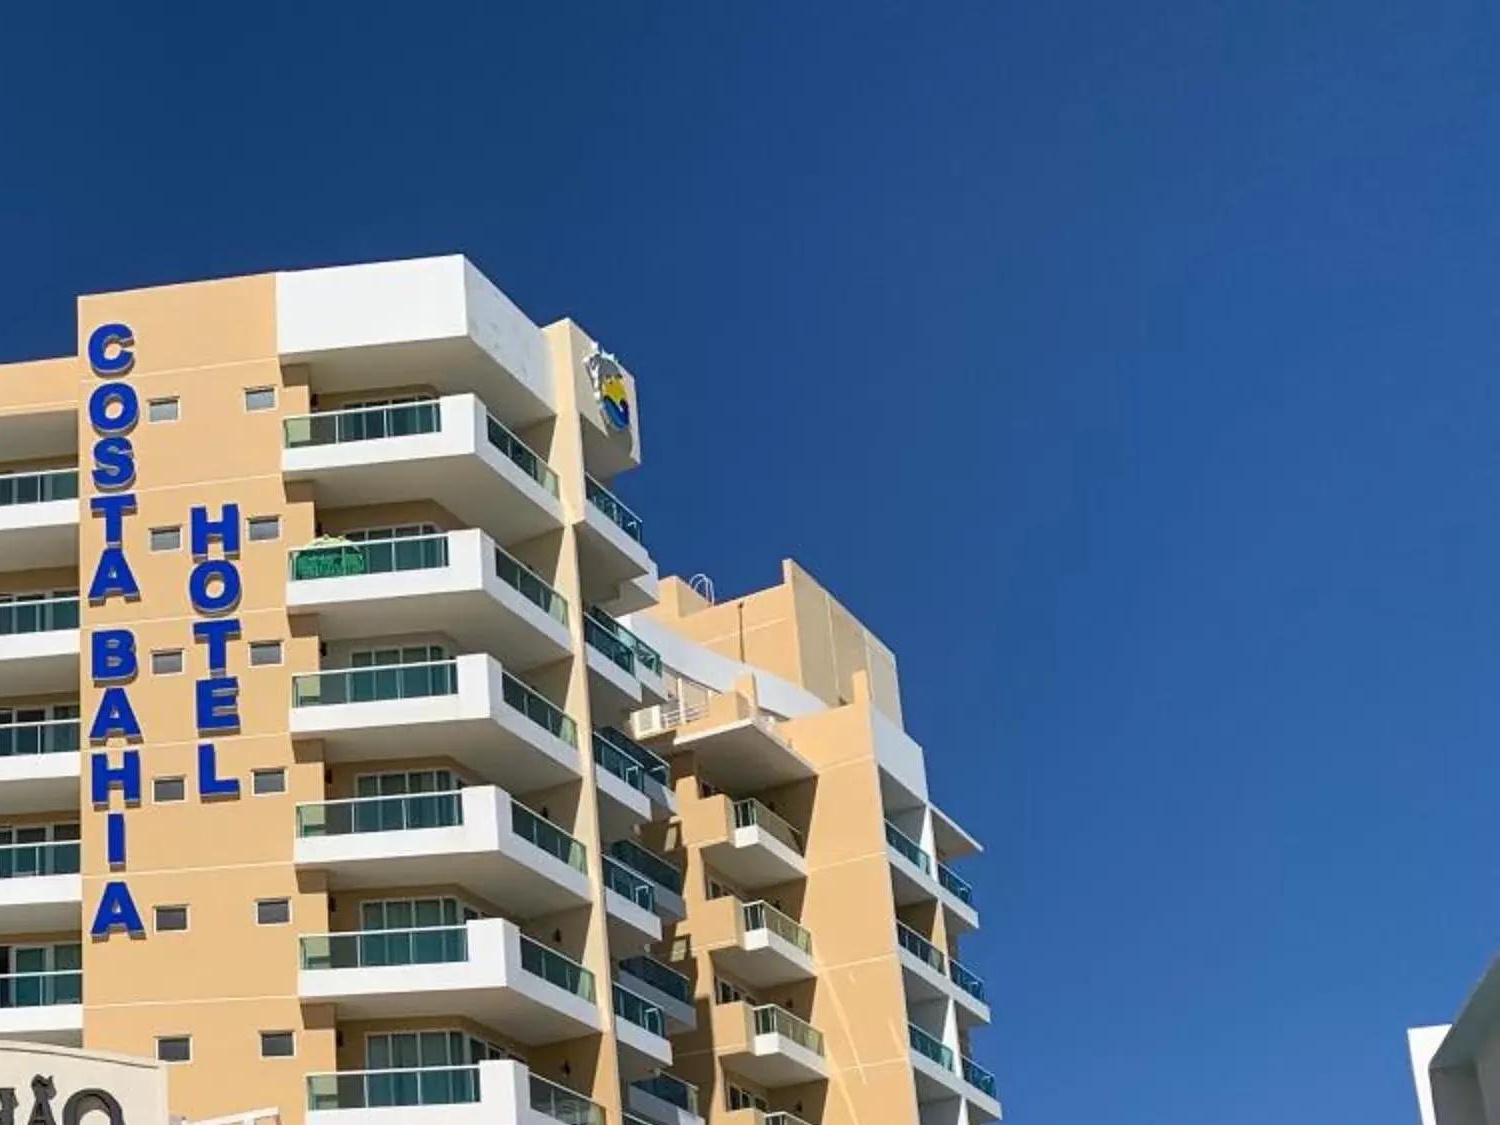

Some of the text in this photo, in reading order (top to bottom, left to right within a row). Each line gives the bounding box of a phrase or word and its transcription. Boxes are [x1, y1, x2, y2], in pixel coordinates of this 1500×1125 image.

[88, 323, 146, 943] COSTA BAHIA
[190, 503, 242, 803] HOTEL
